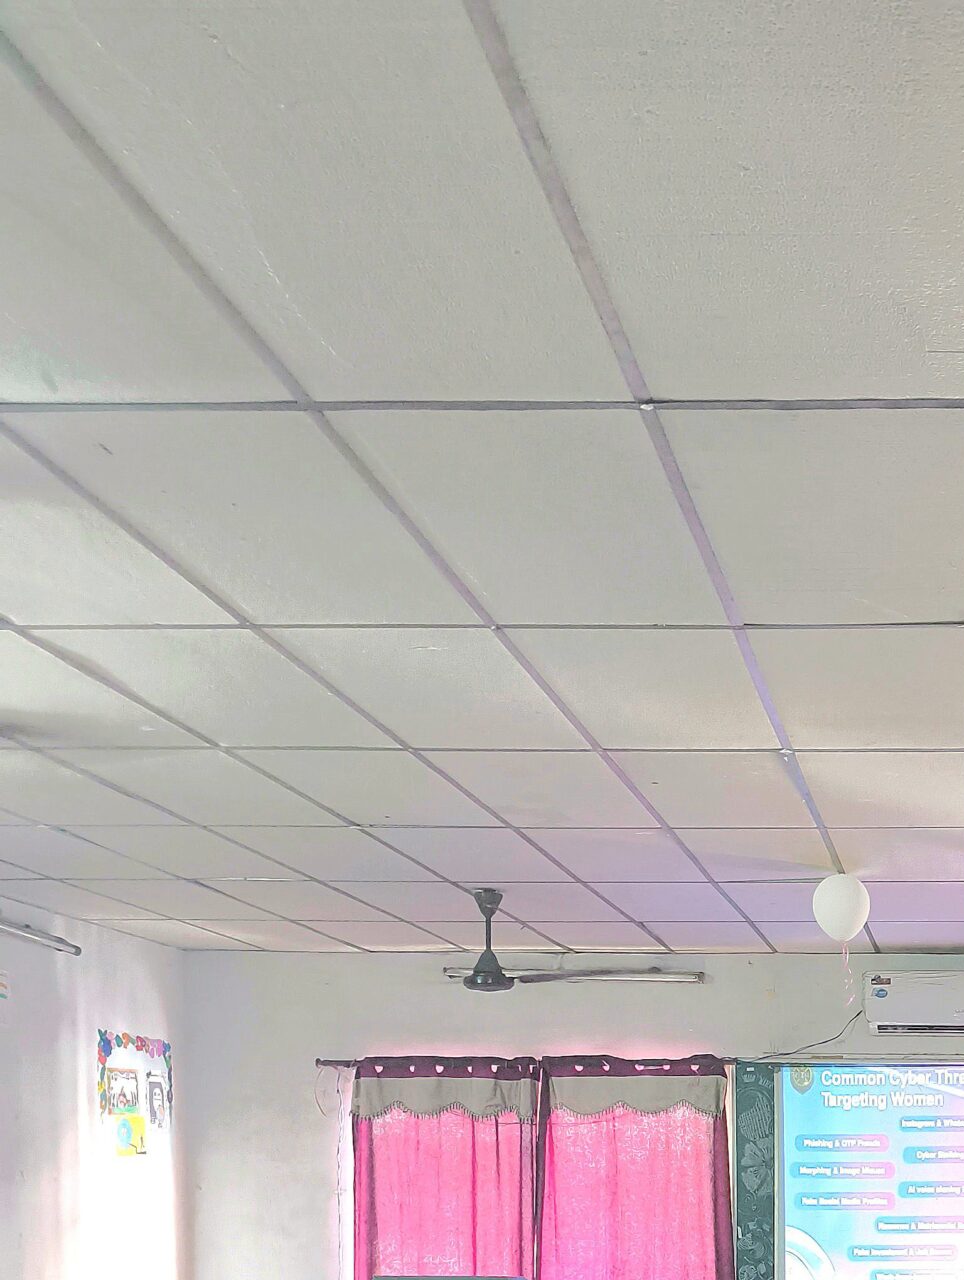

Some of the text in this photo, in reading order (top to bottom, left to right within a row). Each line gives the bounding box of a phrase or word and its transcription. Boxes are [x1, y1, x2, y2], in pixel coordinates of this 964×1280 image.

[821, 1071, 885, 1086] Common
[889, 1071, 931, 1088] Cyber
[821, 1092, 944, 1110] Targeting Women
